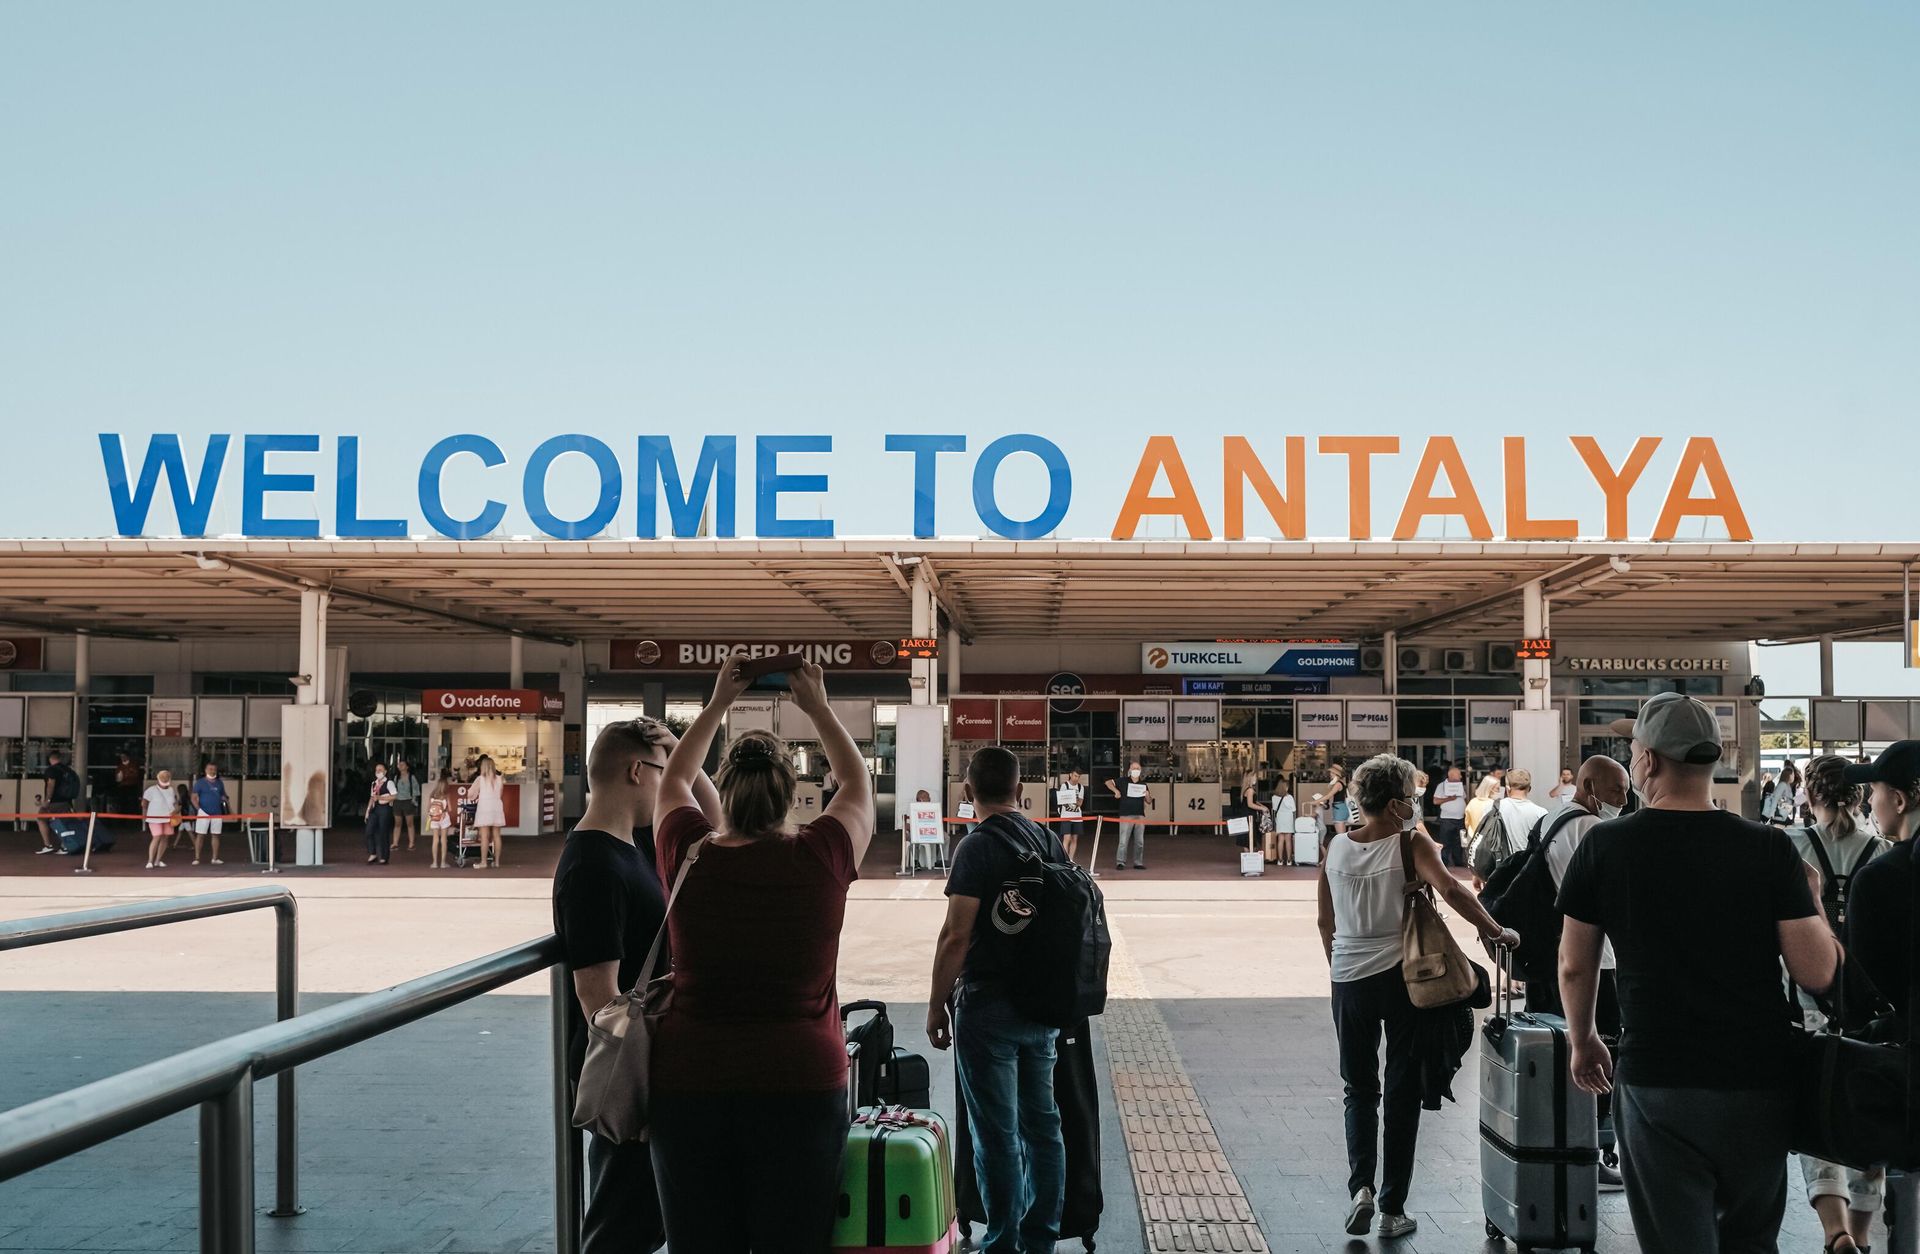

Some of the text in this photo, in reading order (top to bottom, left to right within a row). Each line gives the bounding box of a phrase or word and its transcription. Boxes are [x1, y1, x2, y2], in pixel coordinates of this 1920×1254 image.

[98, 433, 1753, 541] WELCOME TO ANTALYA
[901, 639, 936, 648] ТАКСИ
[1522, 640, 1552, 649] TAXI
[1171, 652, 1242, 664] TURKCELL
[1297, 657, 1355, 666] GOLDPHONE
[1569, 658, 1730, 672] STARBUCKS COFFEE
[1255, 683, 1272, 692] CARD
[457, 694, 522, 708] vodafone
[964, 717, 993, 725] corendon
[1014, 718, 1043, 726] corendon
[1144, 716, 1166, 724] PEGAS
[1194, 716, 1216, 724] PEGAS
[1317, 713, 1339, 722] PEGAS
[1367, 714, 1389, 722] PEGAS
[1188, 798, 1206, 811] 42
